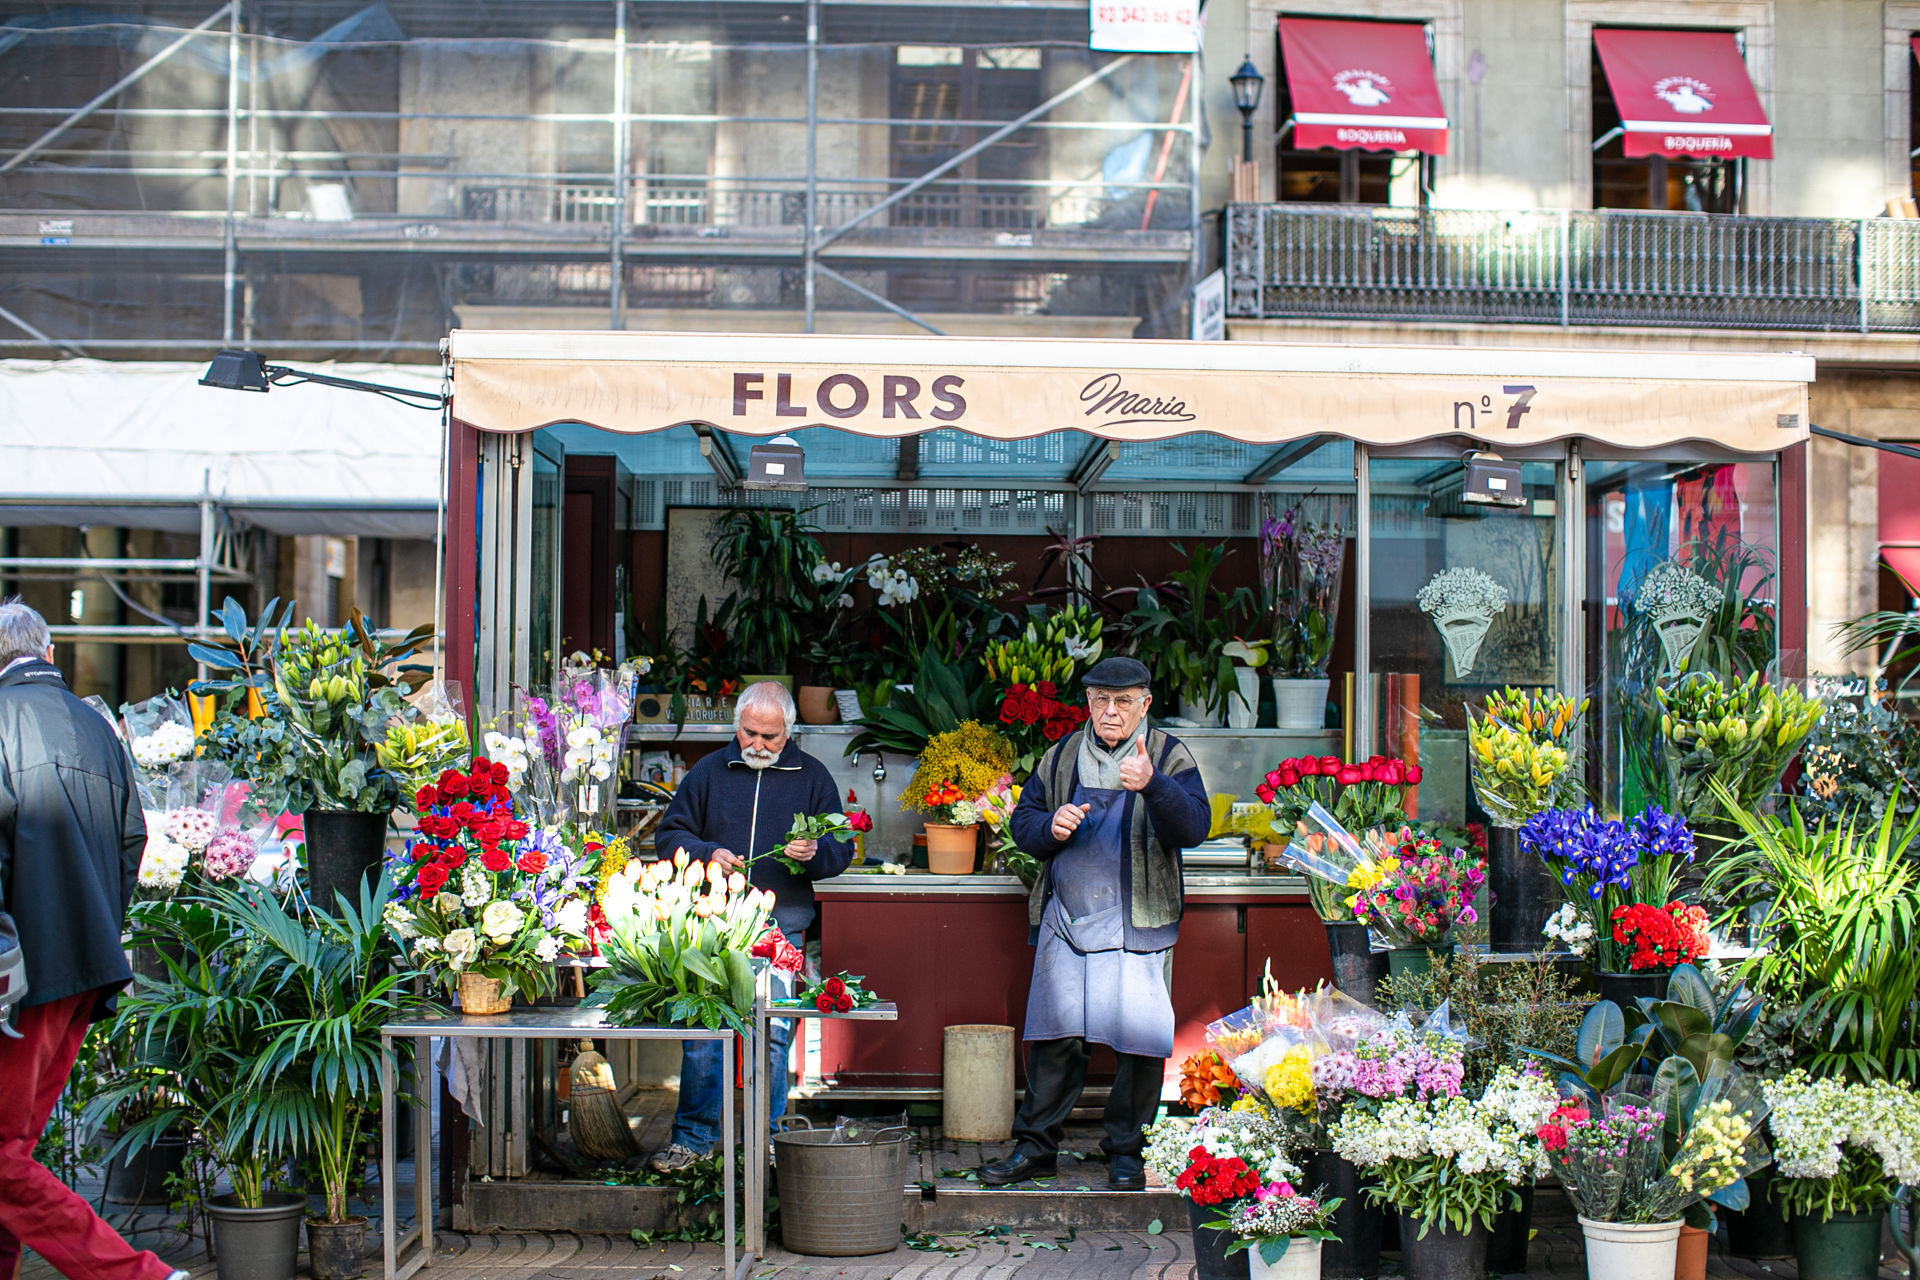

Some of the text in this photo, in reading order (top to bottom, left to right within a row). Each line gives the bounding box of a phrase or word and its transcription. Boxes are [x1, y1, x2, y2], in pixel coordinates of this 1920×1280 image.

[733, 372, 967, 421] FLORS
[1080, 373, 1196, 427] Maria
[1503, 385, 1537, 429] 7
